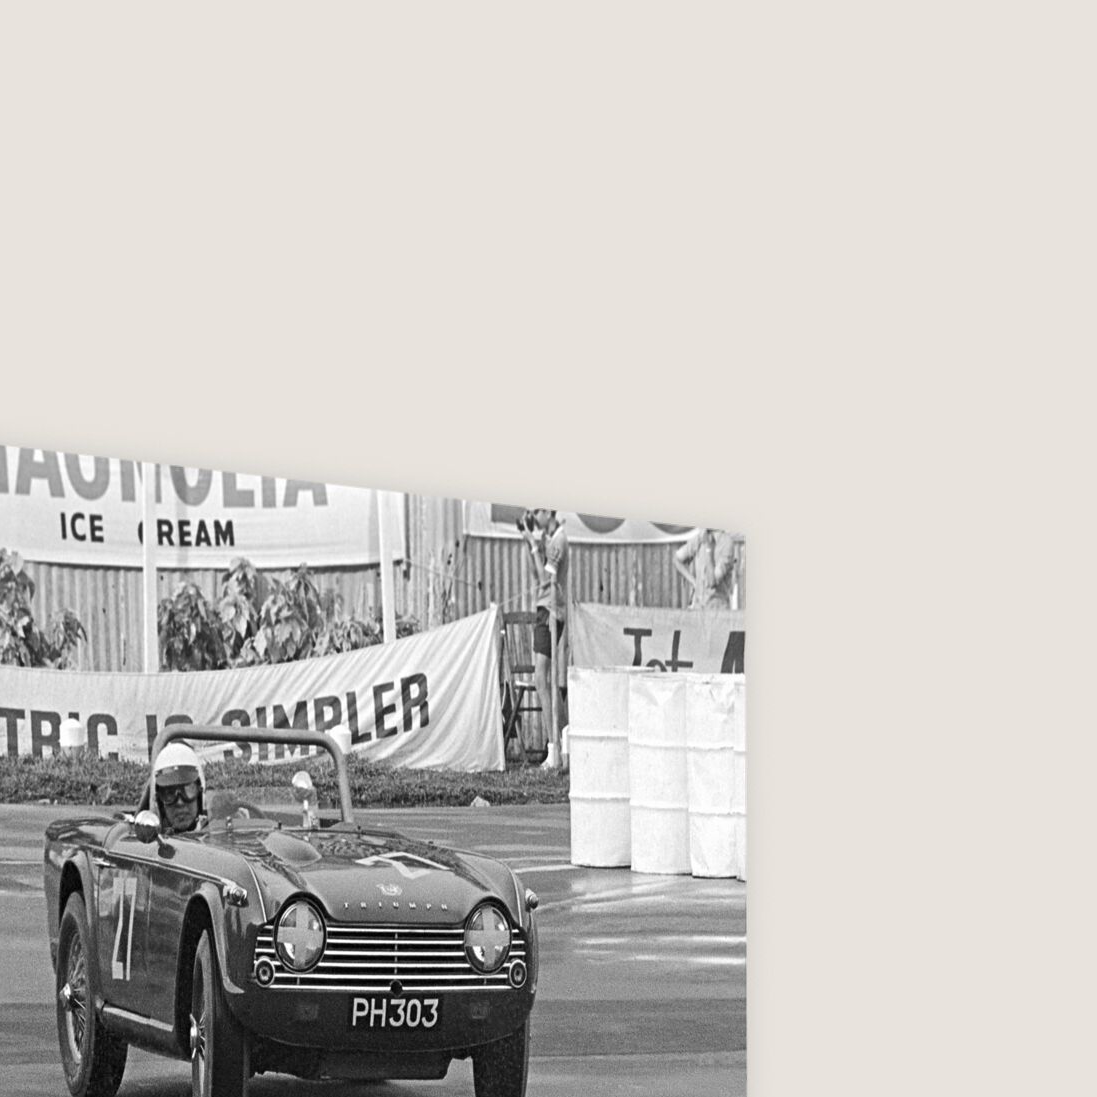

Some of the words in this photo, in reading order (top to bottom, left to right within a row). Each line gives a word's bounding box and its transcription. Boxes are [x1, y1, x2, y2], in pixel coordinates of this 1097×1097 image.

[60, 511, 104, 543] ICE
[138, 519, 235, 547] REAM
[221, 673, 430, 763] SIMPLER
[343, 901, 449, 911] TRIUMPH
[352, 997, 439, 1028] PH303
